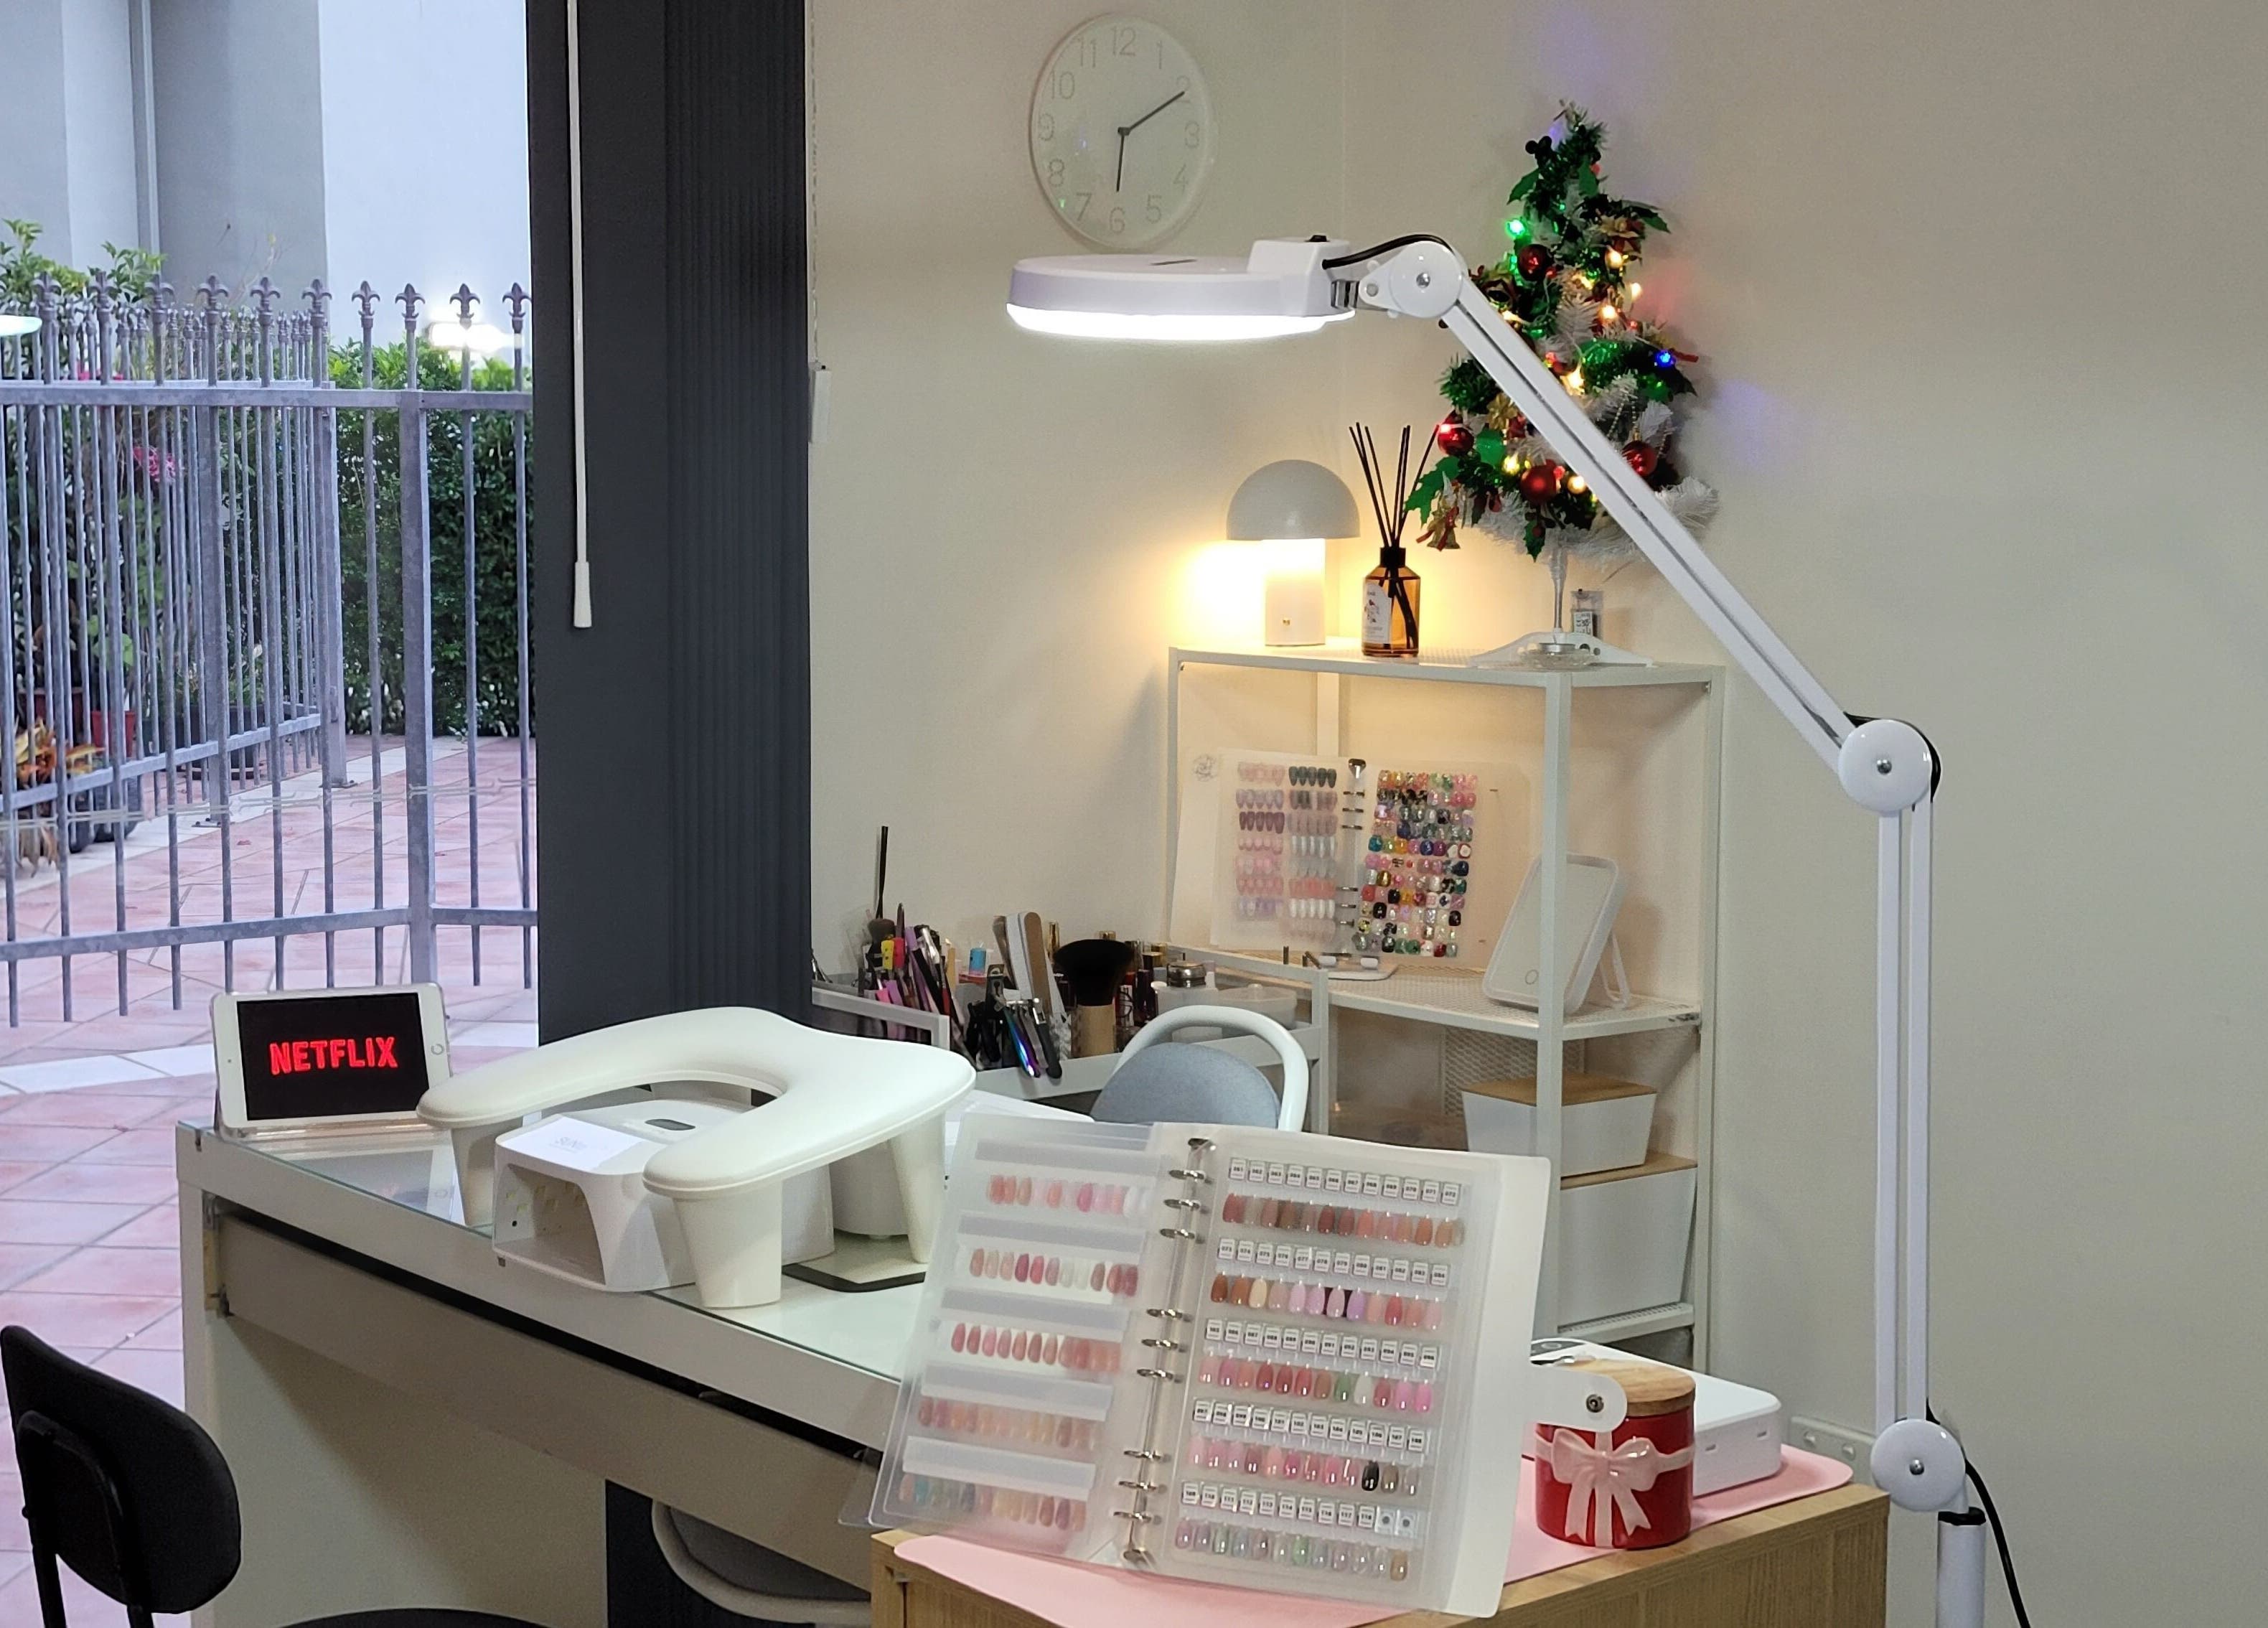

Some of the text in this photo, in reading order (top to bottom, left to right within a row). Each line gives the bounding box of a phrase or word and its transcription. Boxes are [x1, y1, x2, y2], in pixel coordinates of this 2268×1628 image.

[1069, 34, 1097, 68] 11
[1110, 25, 1136, 57] 12
[1049, 70, 1075, 100] 10
[1038, 113, 1055, 141] 9
[1184, 120, 1200, 149] 3
[1048, 158, 1065, 187] 8
[1173, 163, 1189, 194] 4
[1077, 192, 1092, 221] 7
[1109, 207, 1125, 235] 6
[1145, 195, 1162, 224] 5
[269, 1037, 398, 1075] NETFLIX
